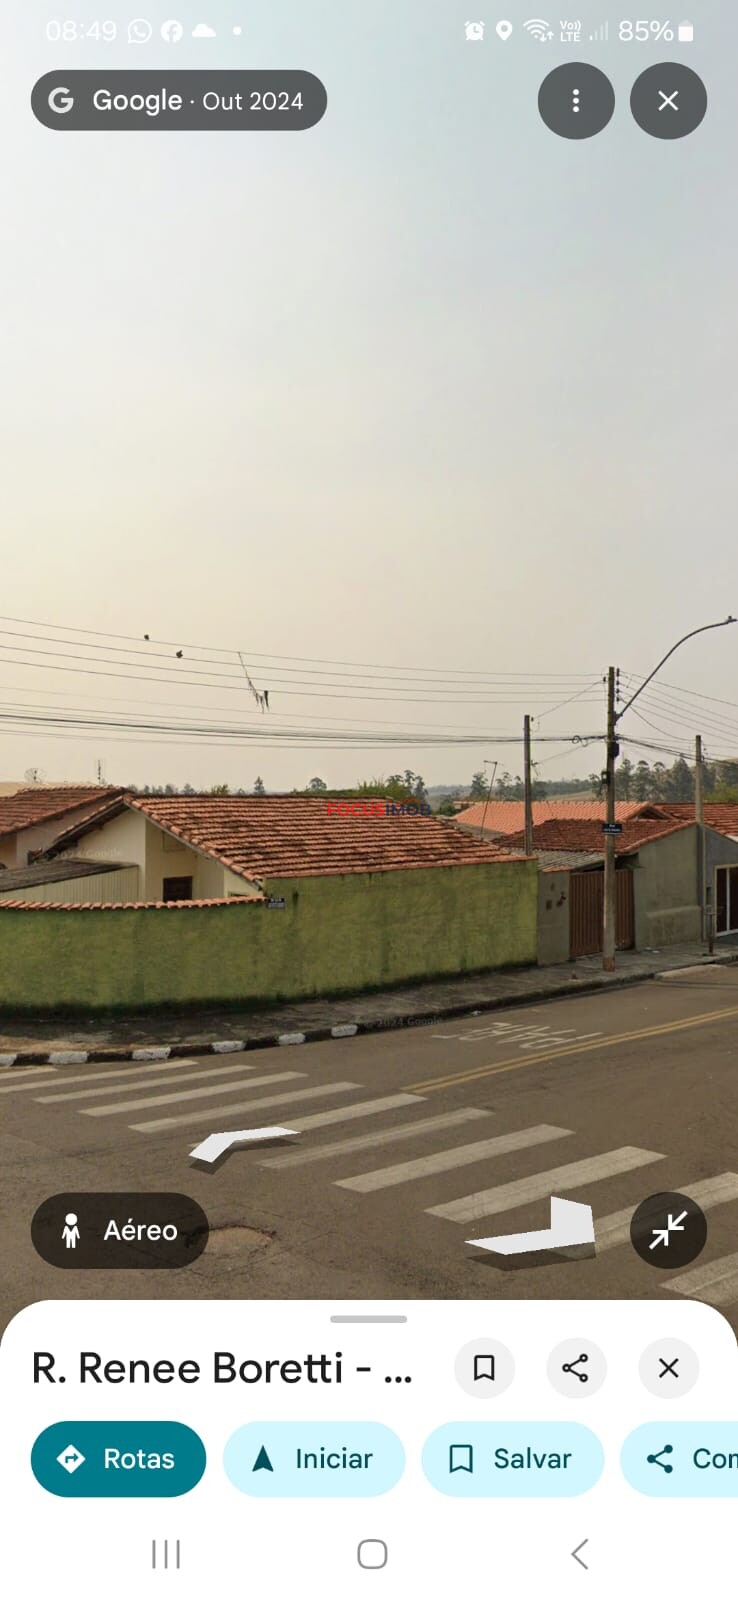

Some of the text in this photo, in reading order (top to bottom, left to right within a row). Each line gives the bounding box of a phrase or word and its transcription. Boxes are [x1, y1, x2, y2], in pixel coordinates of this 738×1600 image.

[46, 21, 117, 41] 08:49
[560, 31, 581, 42] LTE
[618, 20, 674, 42] 85%
[93, 88, 183, 117] Google
[203, 91, 243, 111] Out
[249, 91, 304, 111] 2024
[103, 1217, 178, 1241] Aéreo
[33, 1351, 67, 1384] R.
[79, 1351, 201, 1384] Renee
[213, 1351, 343, 1384] Boretti
[104, 1448, 175, 1470] Rotas
[296, 1446, 374, 1470] Iniciar
[494, 1446, 573, 1470] Salvar
